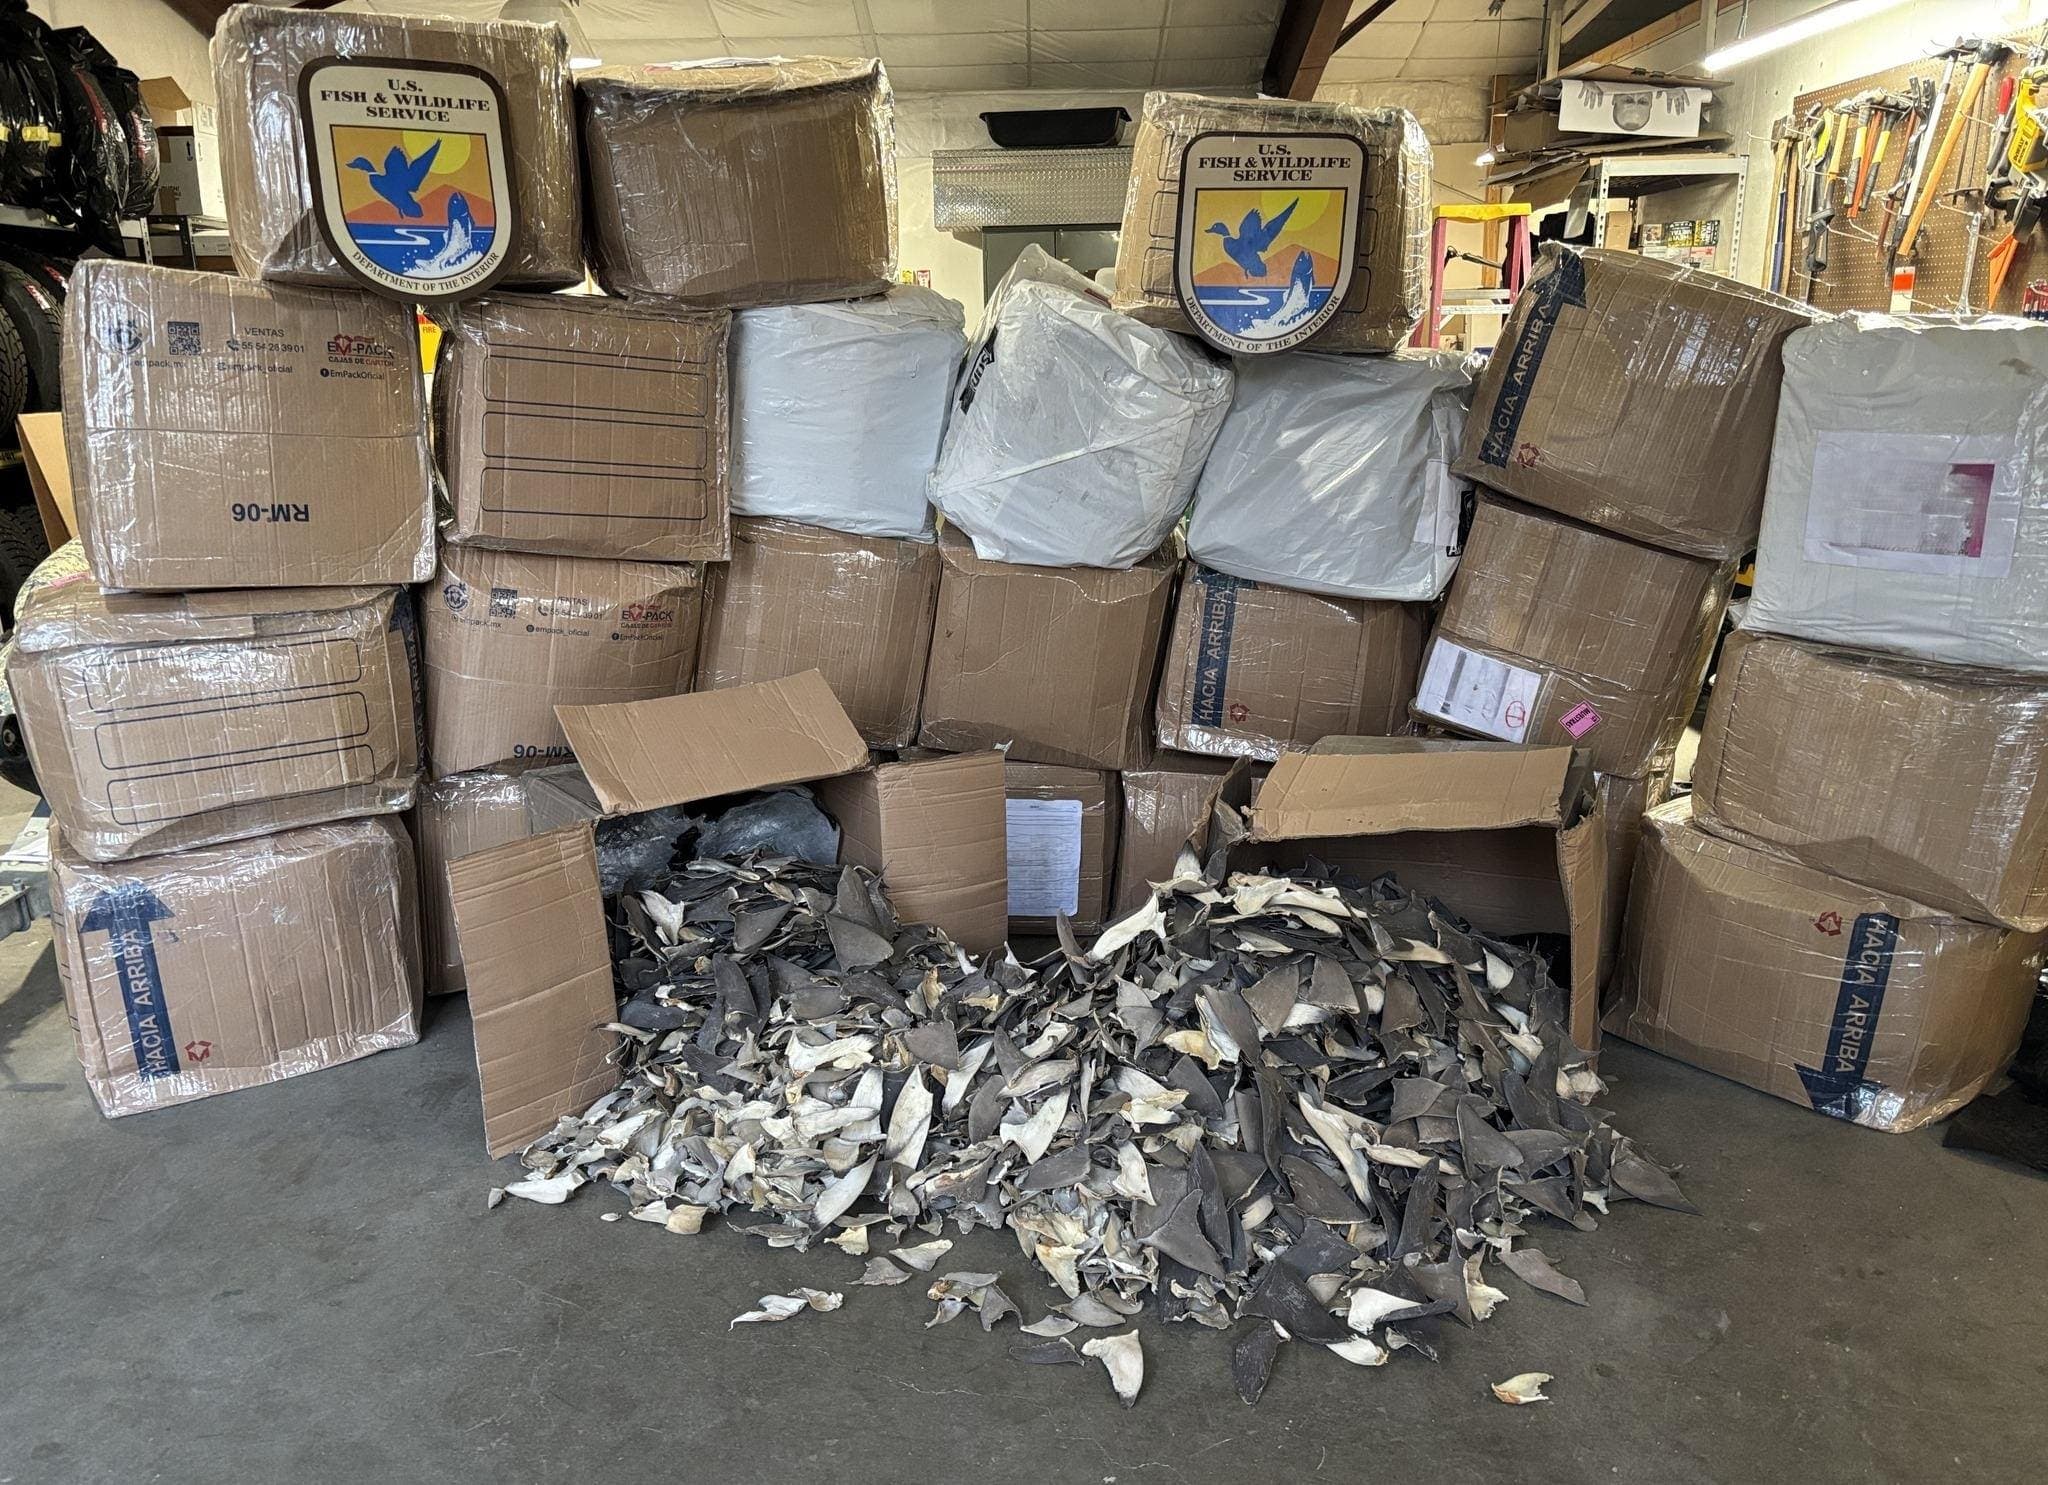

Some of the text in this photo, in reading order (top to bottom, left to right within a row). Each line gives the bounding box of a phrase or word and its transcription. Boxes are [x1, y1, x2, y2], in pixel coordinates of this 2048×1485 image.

[388, 79, 423, 92] U.S.
[320, 90, 490, 112] FISH & WILDLIFE
[366, 106, 450, 122] SERVICE
[1258, 144, 1291, 155] U.S.
[1198, 157, 1351, 169] FISH & WILDLIFE
[1233, 170, 1312, 182] SERVICE
[352, 251, 500, 292] DEPARTMENT OF THE INTERIOR
[244, 327, 285, 338] VENTAS
[1186, 295, 1341, 352] DEPARTMENT OF THE INTERIOR
[1488, 303, 1550, 458] HACIA ARRIBA
[231, 503, 310, 522] RM-06
[1200, 590, 1228, 721] HACIA ARRIBA
[120, 928, 168, 1073] HACIA ARRIBA
[1835, 917, 1889, 1073] HACIA ARRIBA
